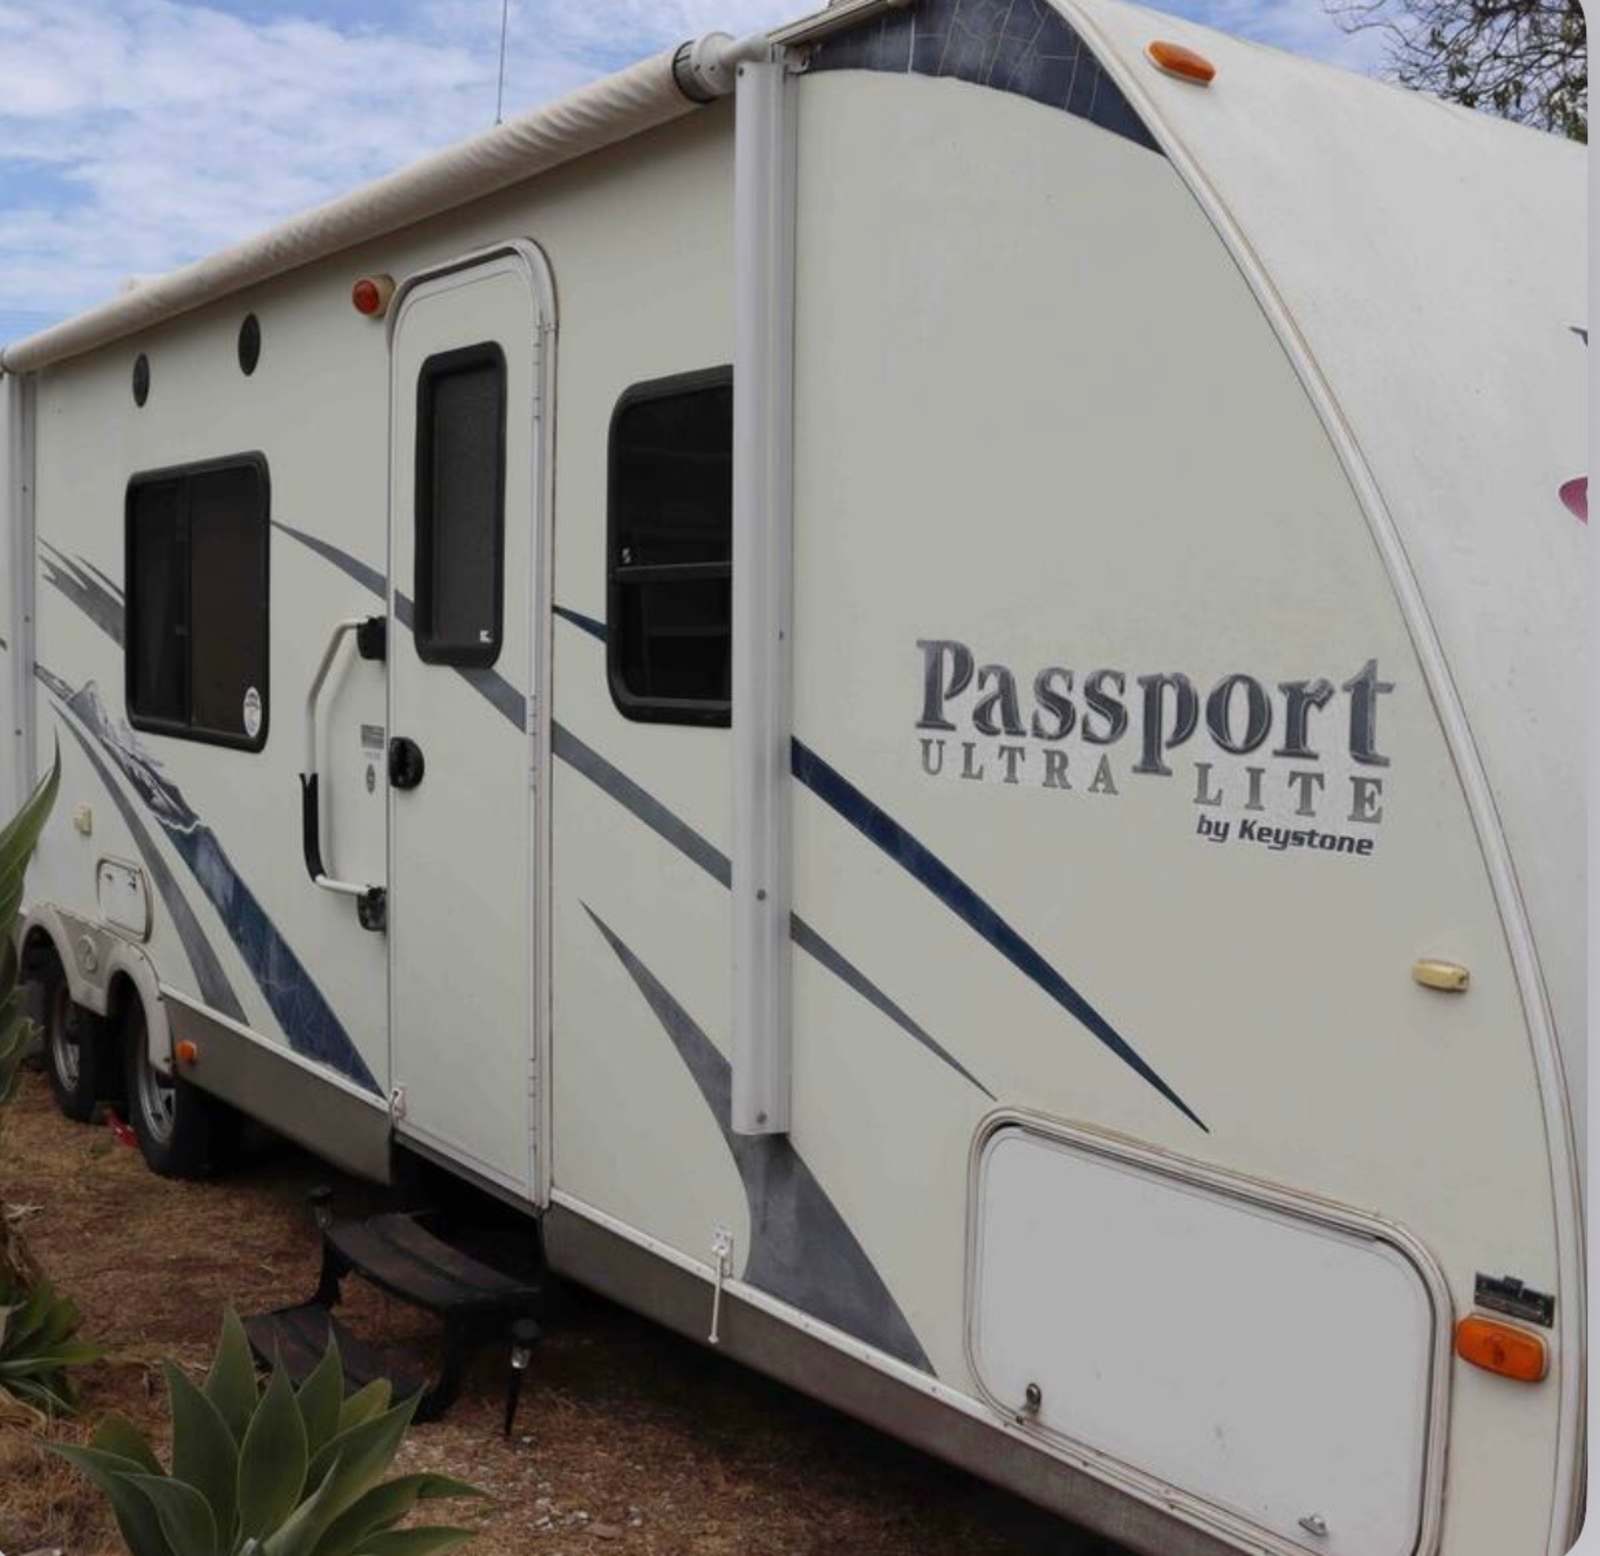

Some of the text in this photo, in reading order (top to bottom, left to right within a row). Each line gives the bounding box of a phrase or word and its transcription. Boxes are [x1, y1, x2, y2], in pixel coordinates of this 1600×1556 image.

[915, 639, 1397, 776] Passport
[919, 738, 1384, 824] ULTRA LITE
[1196, 814, 1375, 857] by Keystone
